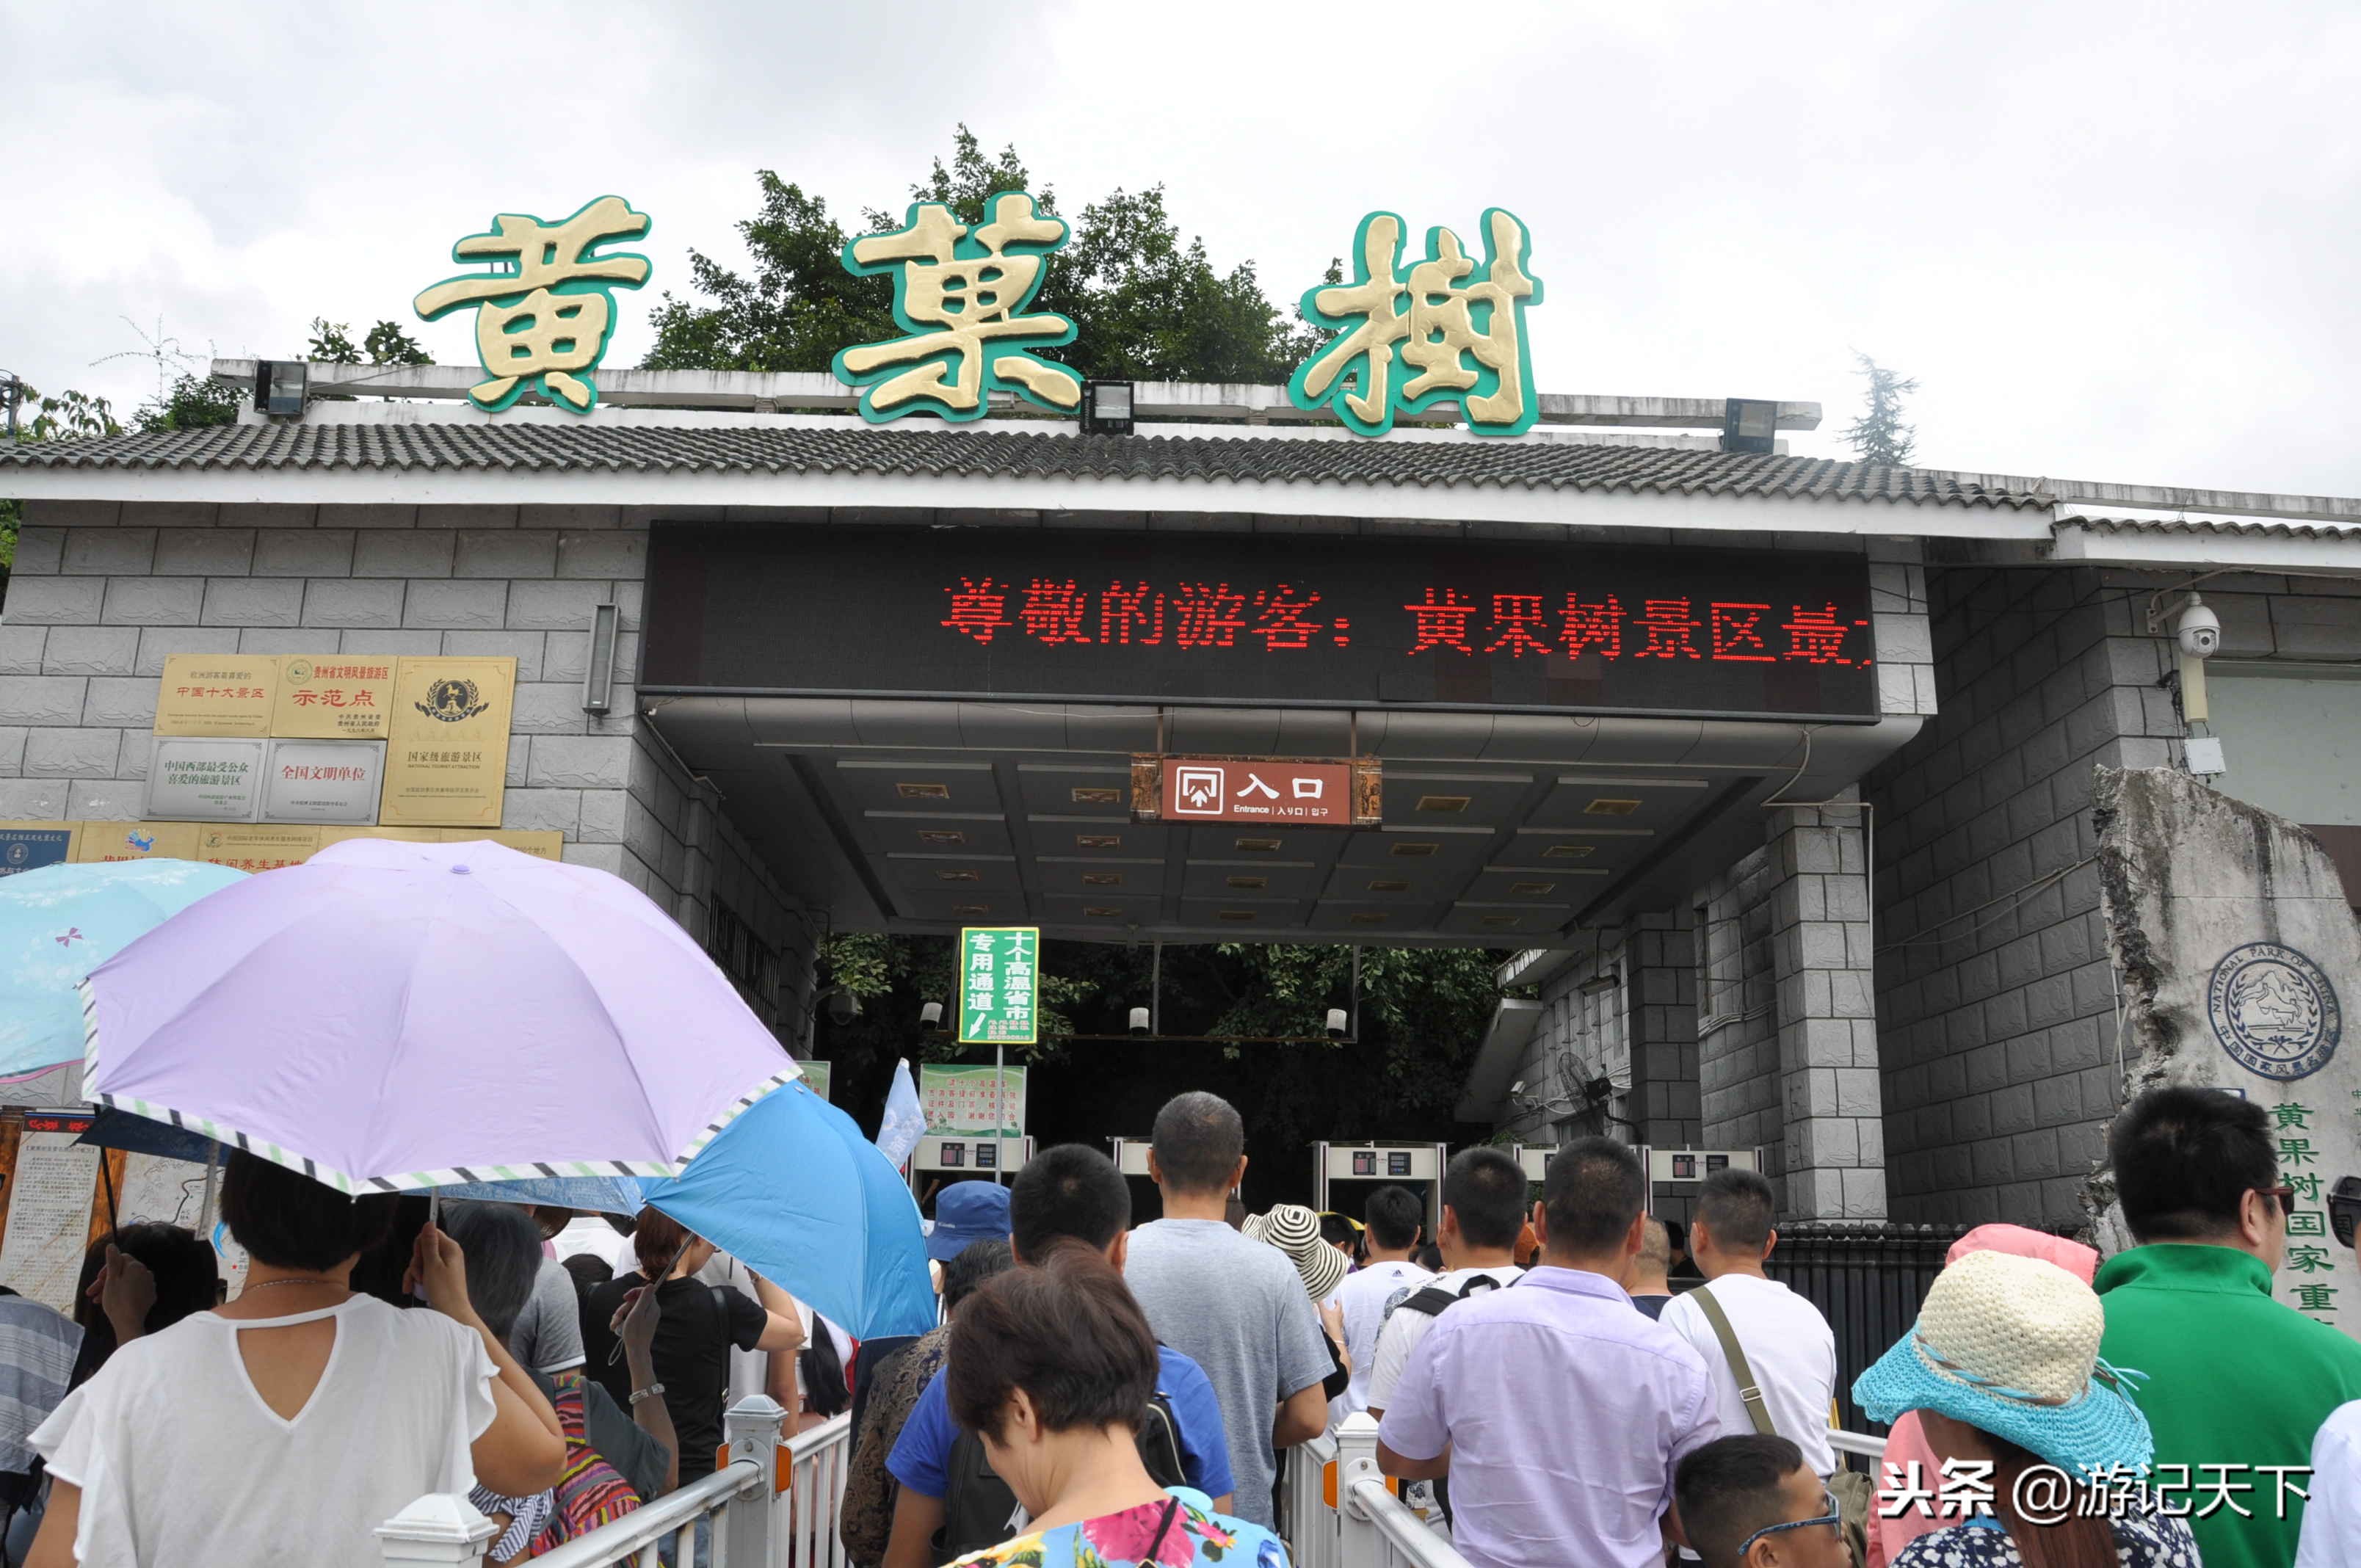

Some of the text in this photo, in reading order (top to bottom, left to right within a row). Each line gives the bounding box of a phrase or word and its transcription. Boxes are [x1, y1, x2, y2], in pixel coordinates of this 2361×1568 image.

[313, 666, 388, 680] 贵州省文明风景旅游区
[176, 686, 265, 698] 中国十大景区
[292, 689, 375, 708] 示范点
[407, 751, 482, 763] 国家级旅游景区
[164, 760, 249, 773] 中国西部最受公众
[282, 765, 366, 782] 全国文明单位
[168, 773, 241, 785] 喜爱的旅游景区
[1236, 773, 1324, 799] 入口
[1233, 805, 1269, 814] Entrance
[1277, 807, 1304, 816] 入り口
[968, 933, 996, 1011] 专用通道
[1003, 932, 1034, 1020] 十个高温省市
[2213, 947, 2336, 1016] NATIONAL PARK OF CHINA
[2267, 1103, 2339, 1324] 黄果树国家重
